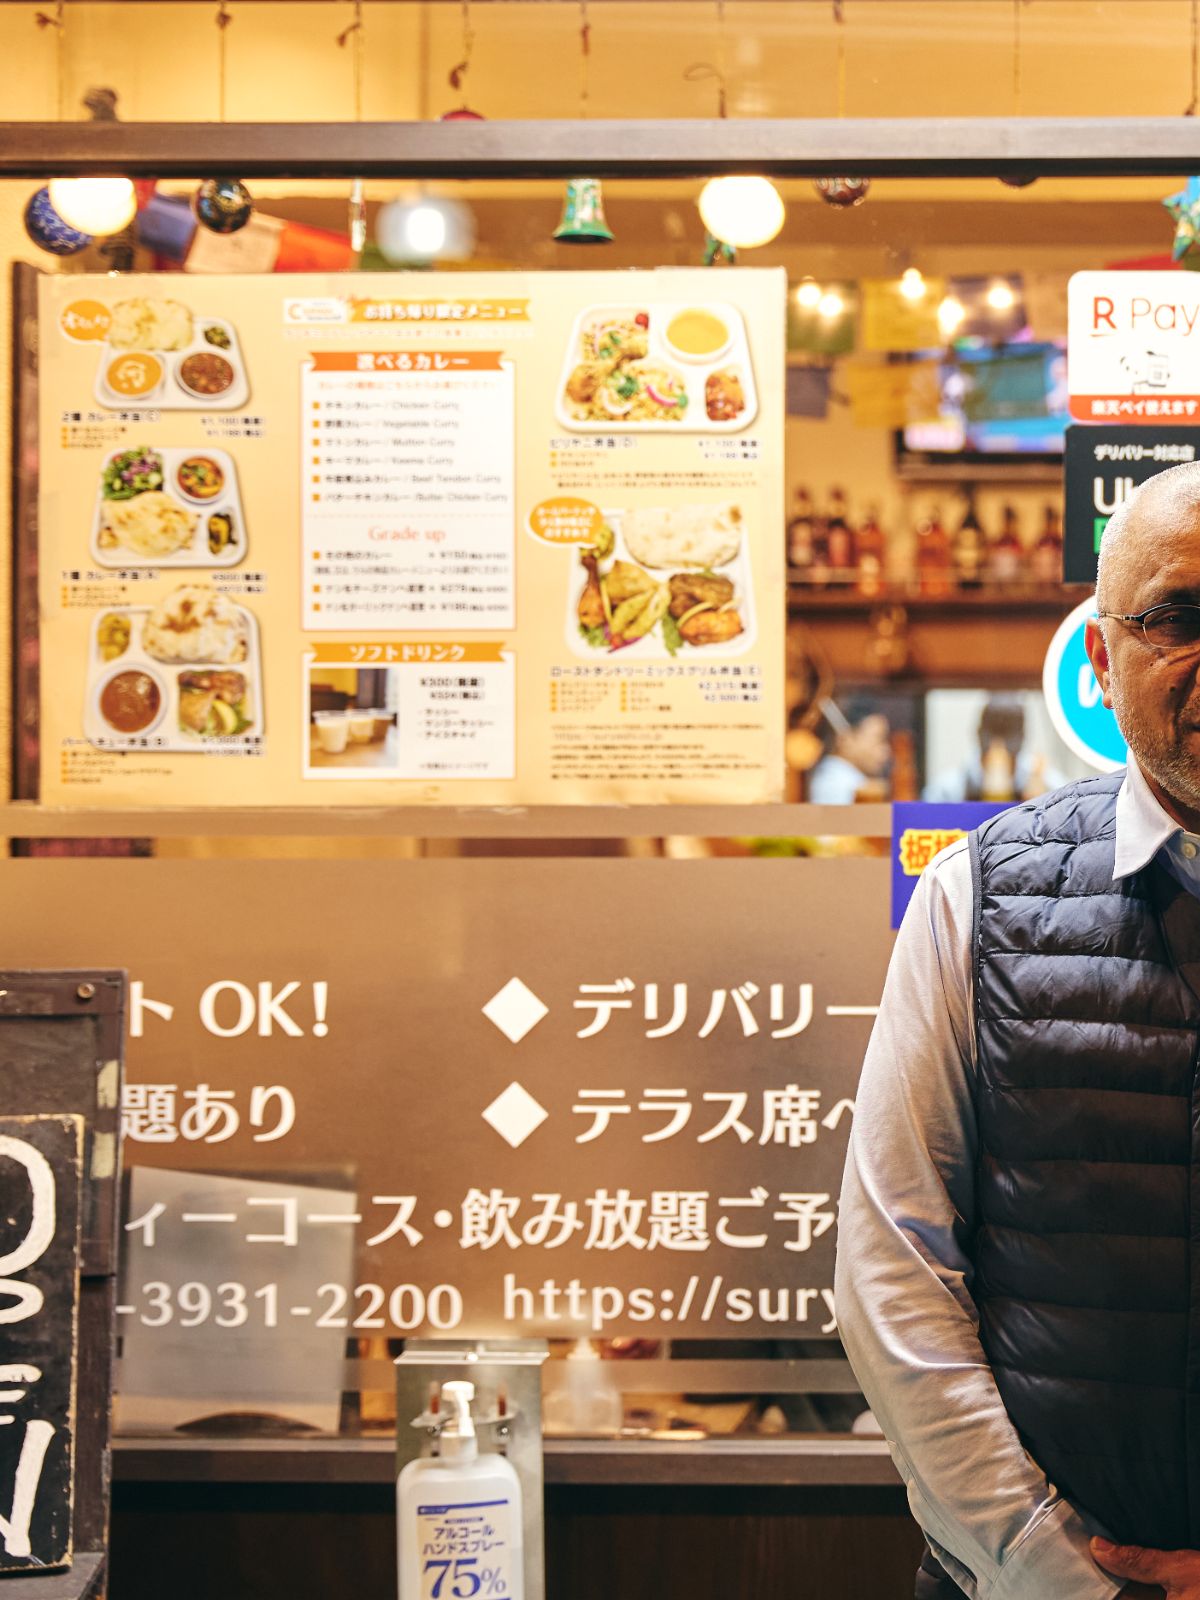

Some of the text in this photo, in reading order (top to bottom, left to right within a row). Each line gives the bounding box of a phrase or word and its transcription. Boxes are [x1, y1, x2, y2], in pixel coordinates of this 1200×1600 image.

[1131, 298, 1200, 336] Pay
[356, 353, 470, 370] 選べるカレー
[434, 402, 459, 412] Curry
[1091, 400, 1199, 416] 楽天ペイ使えます
[434, 420, 459, 430] Curry
[430, 438, 455, 448] Curry
[428, 456, 454, 467] Curry
[476, 475, 501, 485] Curry
[368, 525, 446, 543] Grade up
[349, 644, 465, 661] ソフトドリンク
[199, 980, 329, 1038] OK!
[573, 977, 880, 1040] デリバリー
[121, 1084, 296, 1143] 題あり
[124, 1186, 840, 1252] ィーコース・飲み放題ご予
[115, 1281, 463, 1329] -3931-2200
[433, 1524, 495, 1541] アルコール
[422, 1540, 505, 1556] ハンドスプレー
[422, 1557, 506, 1600] 75%
